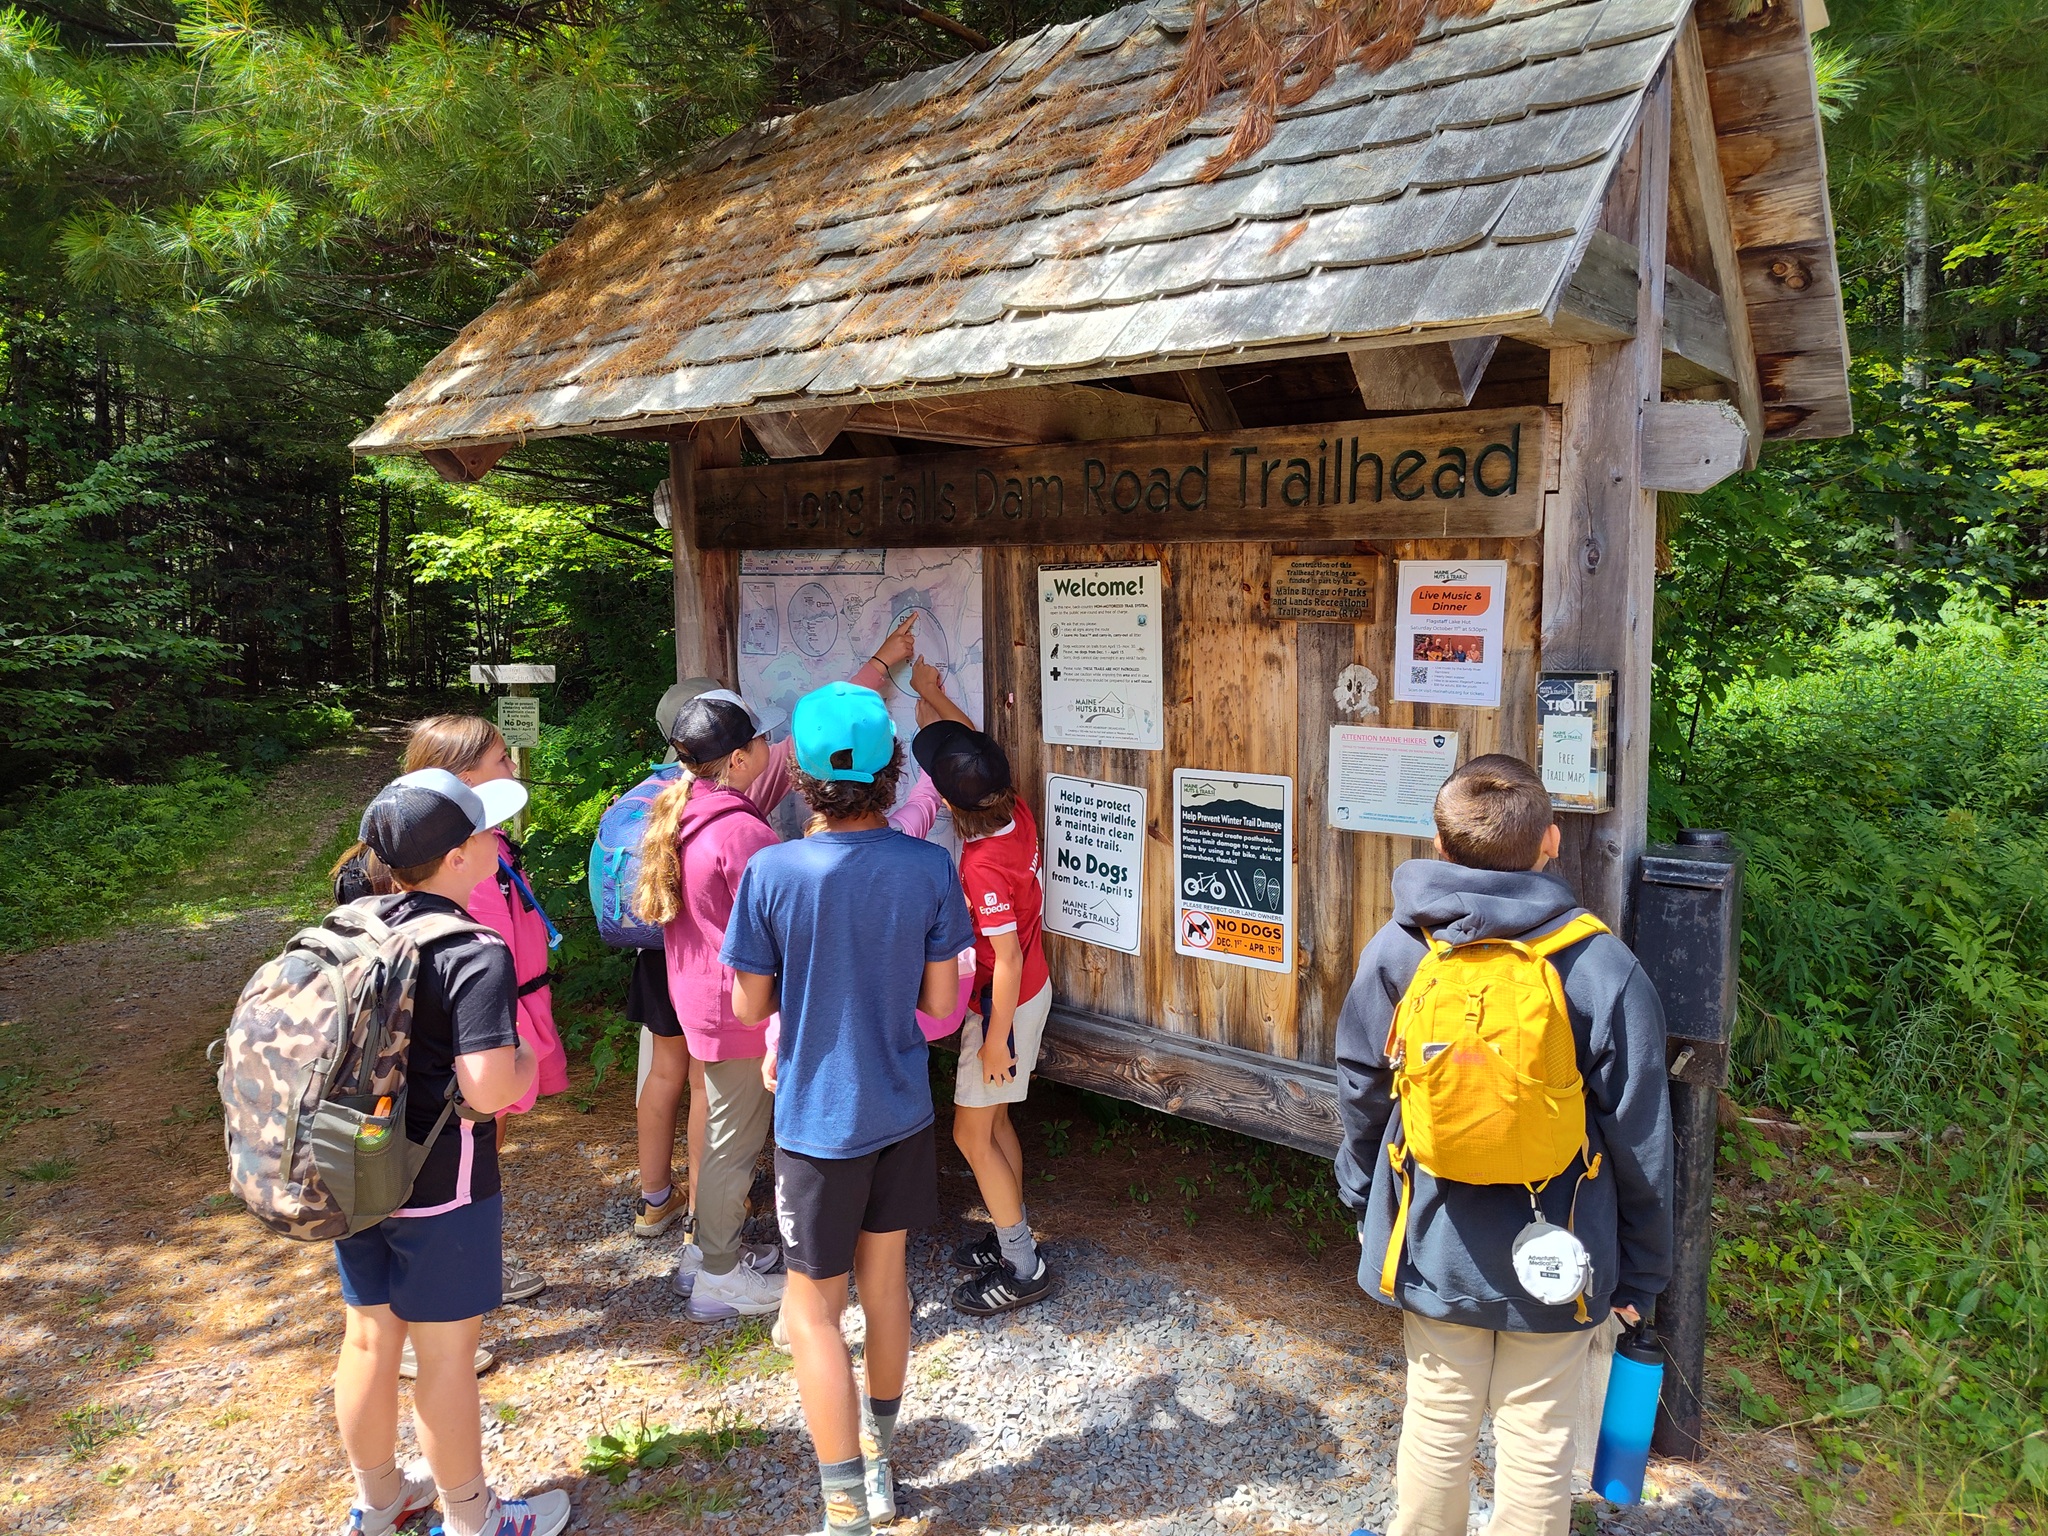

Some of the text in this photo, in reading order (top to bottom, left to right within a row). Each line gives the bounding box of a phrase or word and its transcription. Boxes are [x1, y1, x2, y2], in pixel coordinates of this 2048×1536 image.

[783, 483, 865, 539] Long
[881, 471, 957, 525] Falls
[973, 466, 1064, 522] Dam
[1083, 448, 1209, 516] Road
[1231, 423, 1521, 511] Trailhead
[1053, 575, 1144, 597] Welcome!
[1276, 587, 1367, 597] Maine Bureau of Parks
[1290, 597, 1313, 606] Lands
[1315, 598, 1369, 608] Recreational
[1419, 591, 1482, 600] Live Music &
[1278, 607, 1363, 619] Trails Program (RTP)
[1432, 602, 1467, 611] Dinner
[516, 720, 533, 728] Dogs
[1341, 734, 1427, 745] ATTENTION MAINE HIKERS
[1558, 752, 1575, 765] FREE
[1060, 789, 1131, 813] Help us protect
[1054, 803, 1137, 828] wintering wildlife
[1182, 811, 1282, 832] Help Prevent Winter Trail Damage
[1055, 815, 1134, 841] & maintain clean
[1065, 831, 1122, 852] & safe trails.
[1182, 836, 1201, 844] Please
[1216, 840, 1241, 849] damage
[1262, 845, 1282, 853] winter
[1243, 834, 1274, 843] postholes.
[1182, 854, 1238, 865] snowshoes, thanks!
[1198, 846, 1206, 854] by
[1208, 848, 1224, 856] using
[1242, 851, 1257, 859] bike,
[1259, 853, 1272, 861] skis,
[1058, 847, 1081, 871] No
[1086, 853, 1128, 885] Dogs
[1052, 871, 1071, 884] from
[1100, 882, 1122, 896] April
[1124, 888, 1133, 898] 15
[1063, 899, 1087, 911] MAINE
[1242, 908, 1257, 916] LAND
[1258, 911, 1283, 921] OWNERS
[1216, 918, 1281, 939] NO DOGS
[1216, 937, 1233, 948] DEC.
[1249, 943, 1266, 954] APR.
